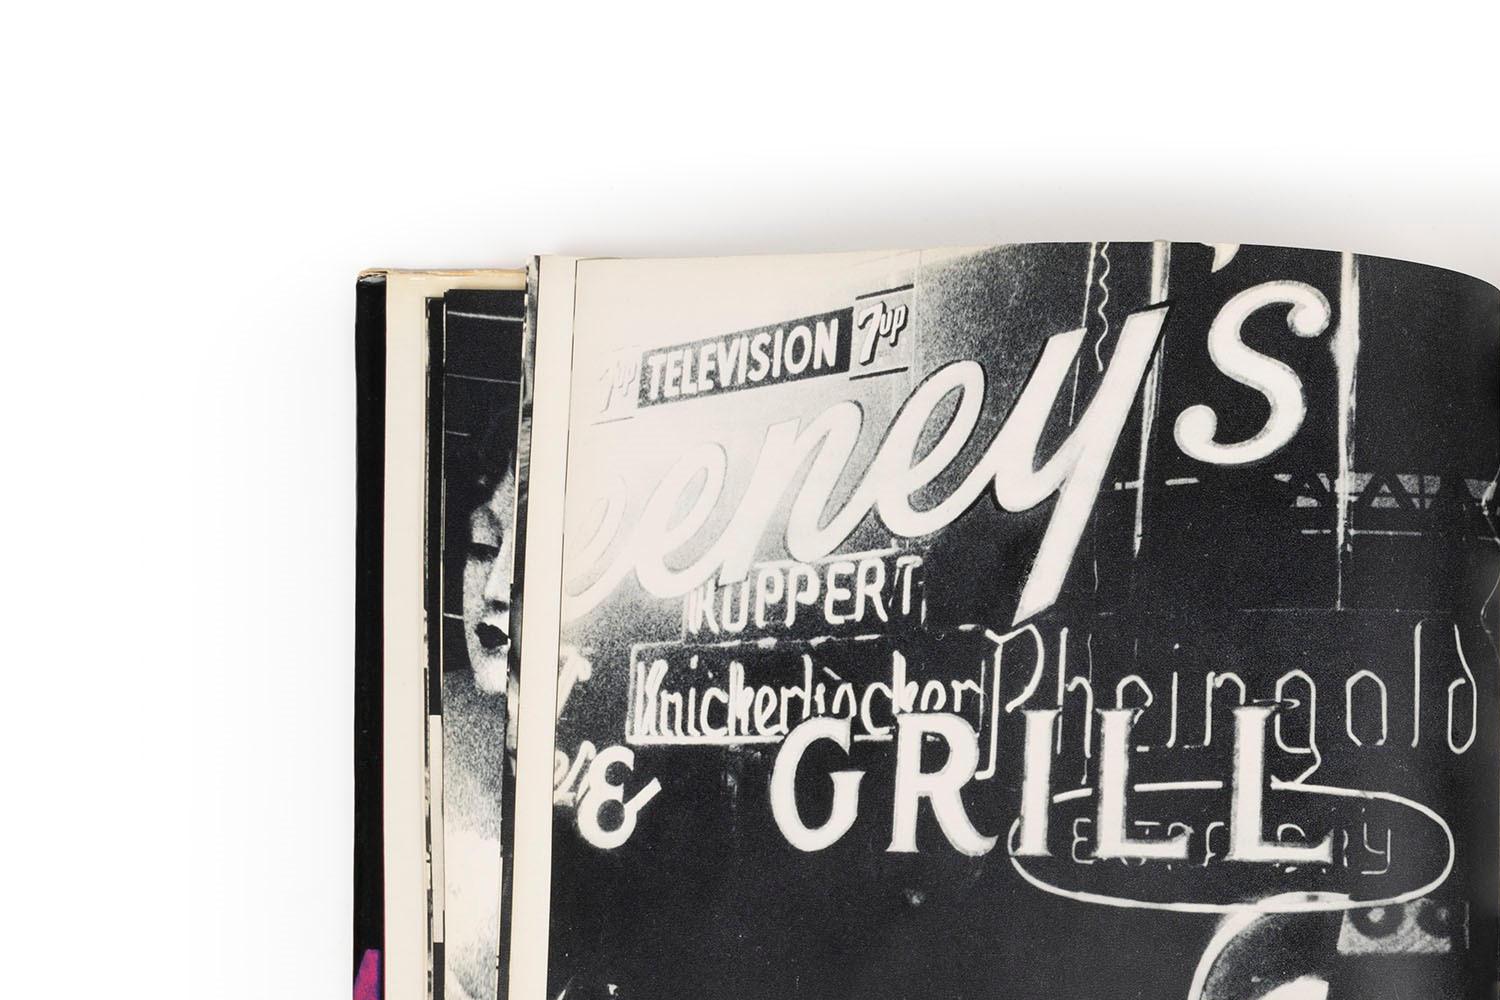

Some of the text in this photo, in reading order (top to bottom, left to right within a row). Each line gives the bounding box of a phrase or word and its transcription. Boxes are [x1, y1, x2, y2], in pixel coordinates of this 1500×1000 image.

[648, 318, 839, 400] TELEVISION
[577, 745, 662, 850] &
[770, 706, 1333, 862] GRILL
